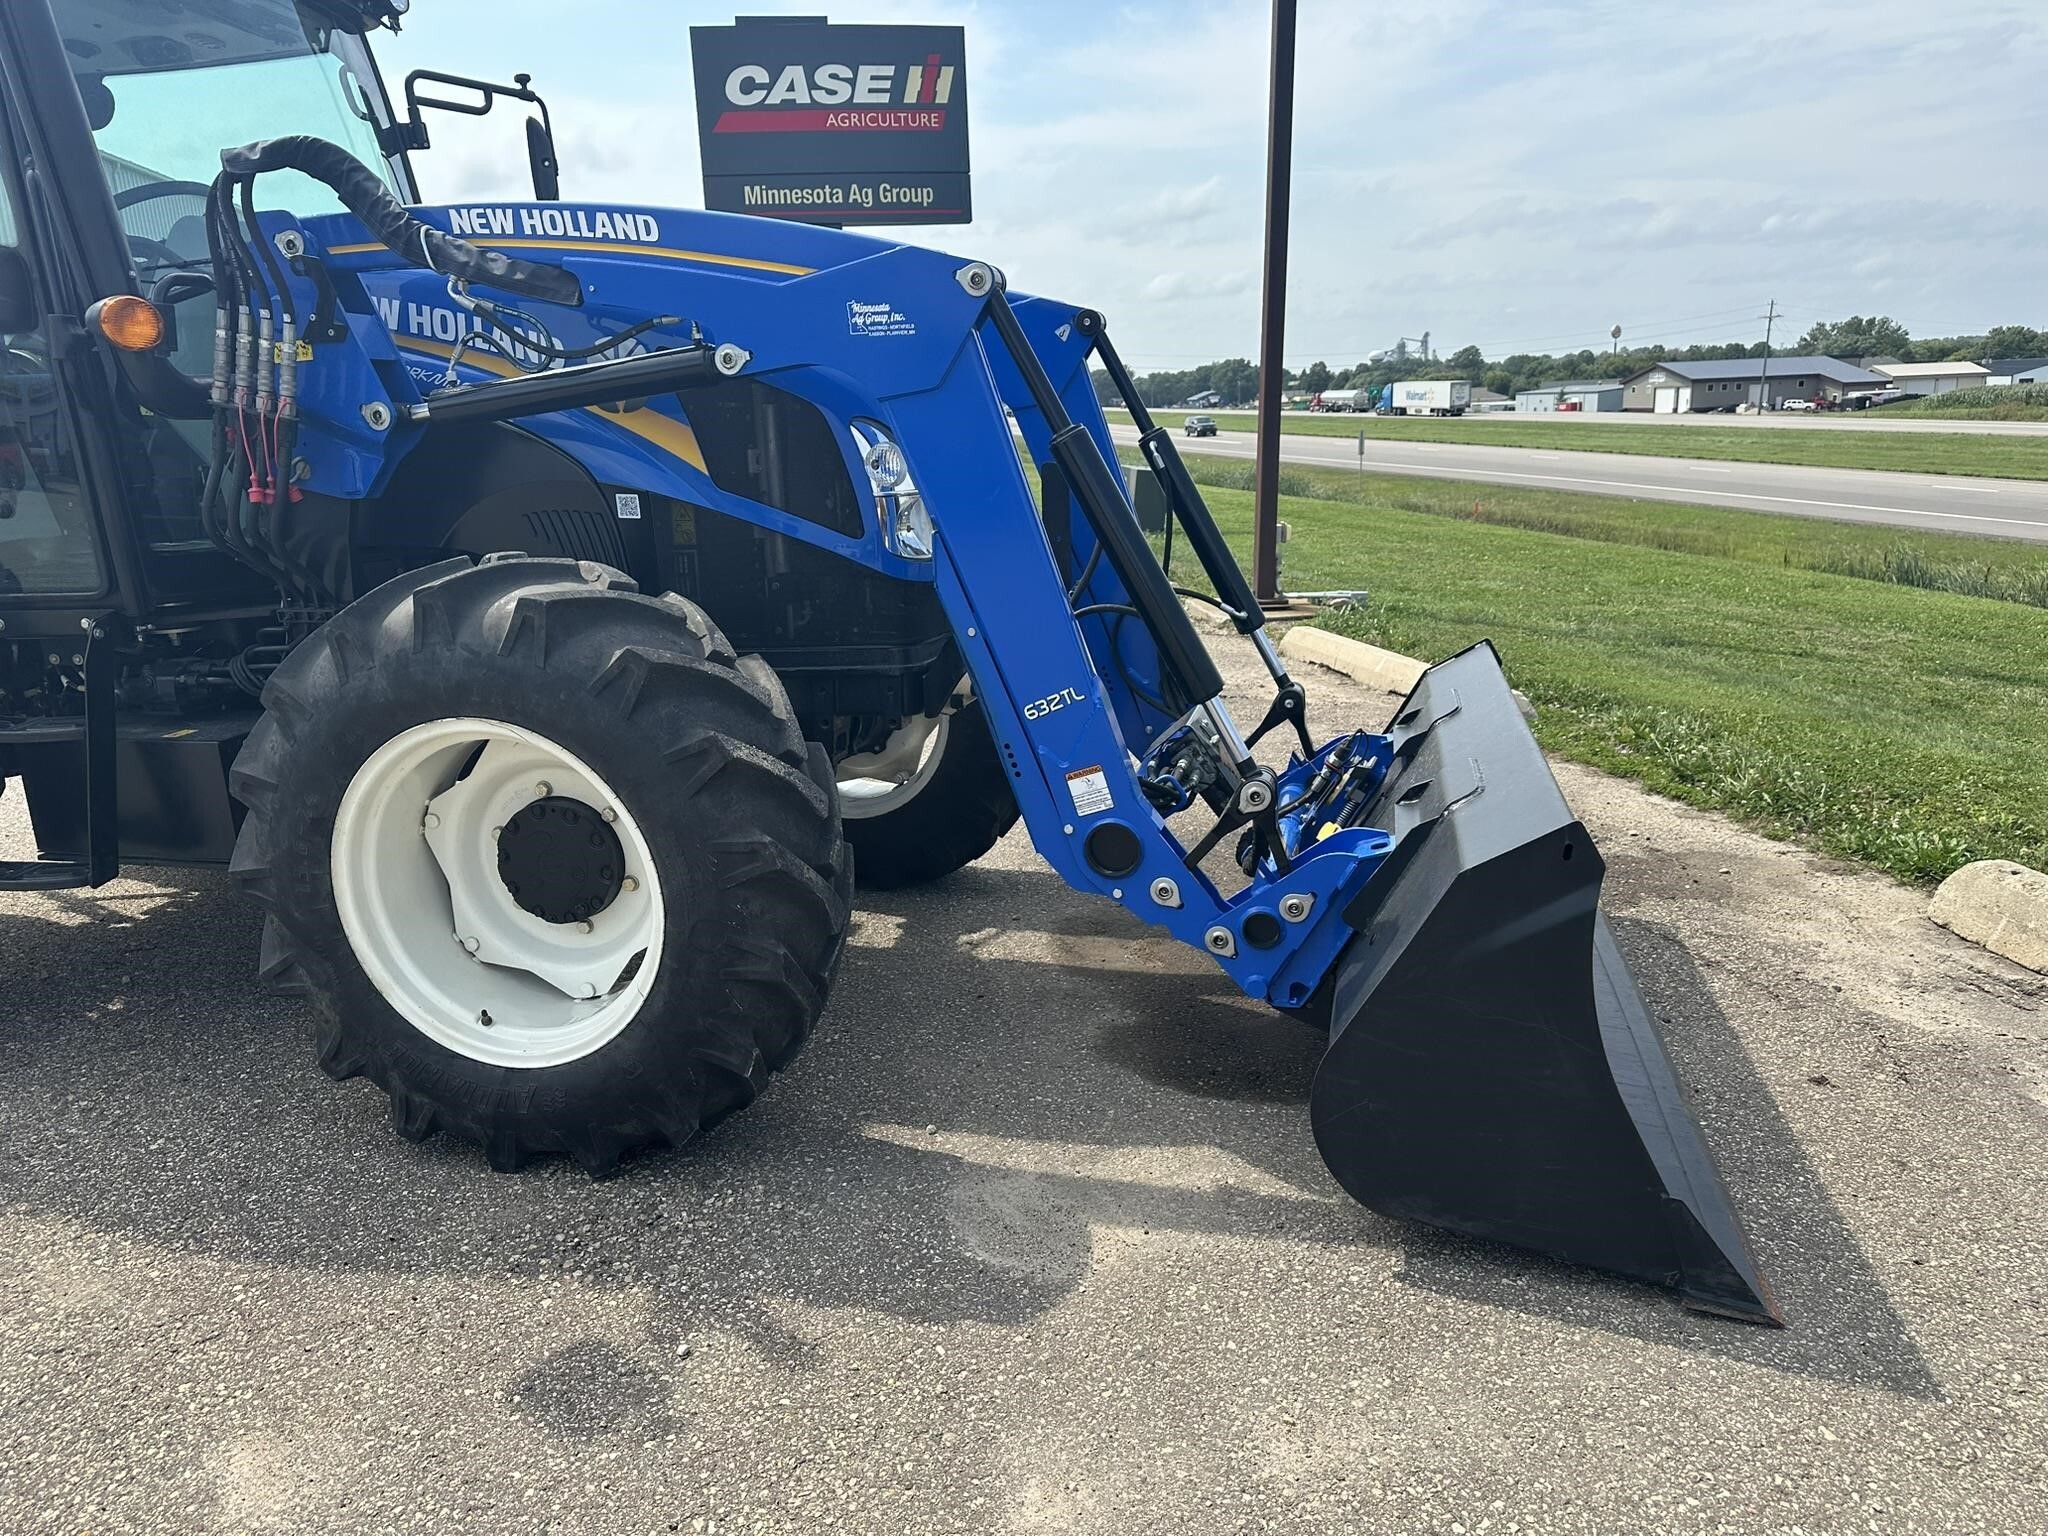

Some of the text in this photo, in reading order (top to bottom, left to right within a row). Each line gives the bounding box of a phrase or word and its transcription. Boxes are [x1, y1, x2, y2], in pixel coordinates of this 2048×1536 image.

[725, 64, 896, 106] CASE
[826, 112, 940, 128] AGRICULTURE
[744, 183, 934, 207] Minnesota Ag Group
[448, 208, 659, 242] NEW HOLLAND
[1024, 687, 1085, 720] 632TL
